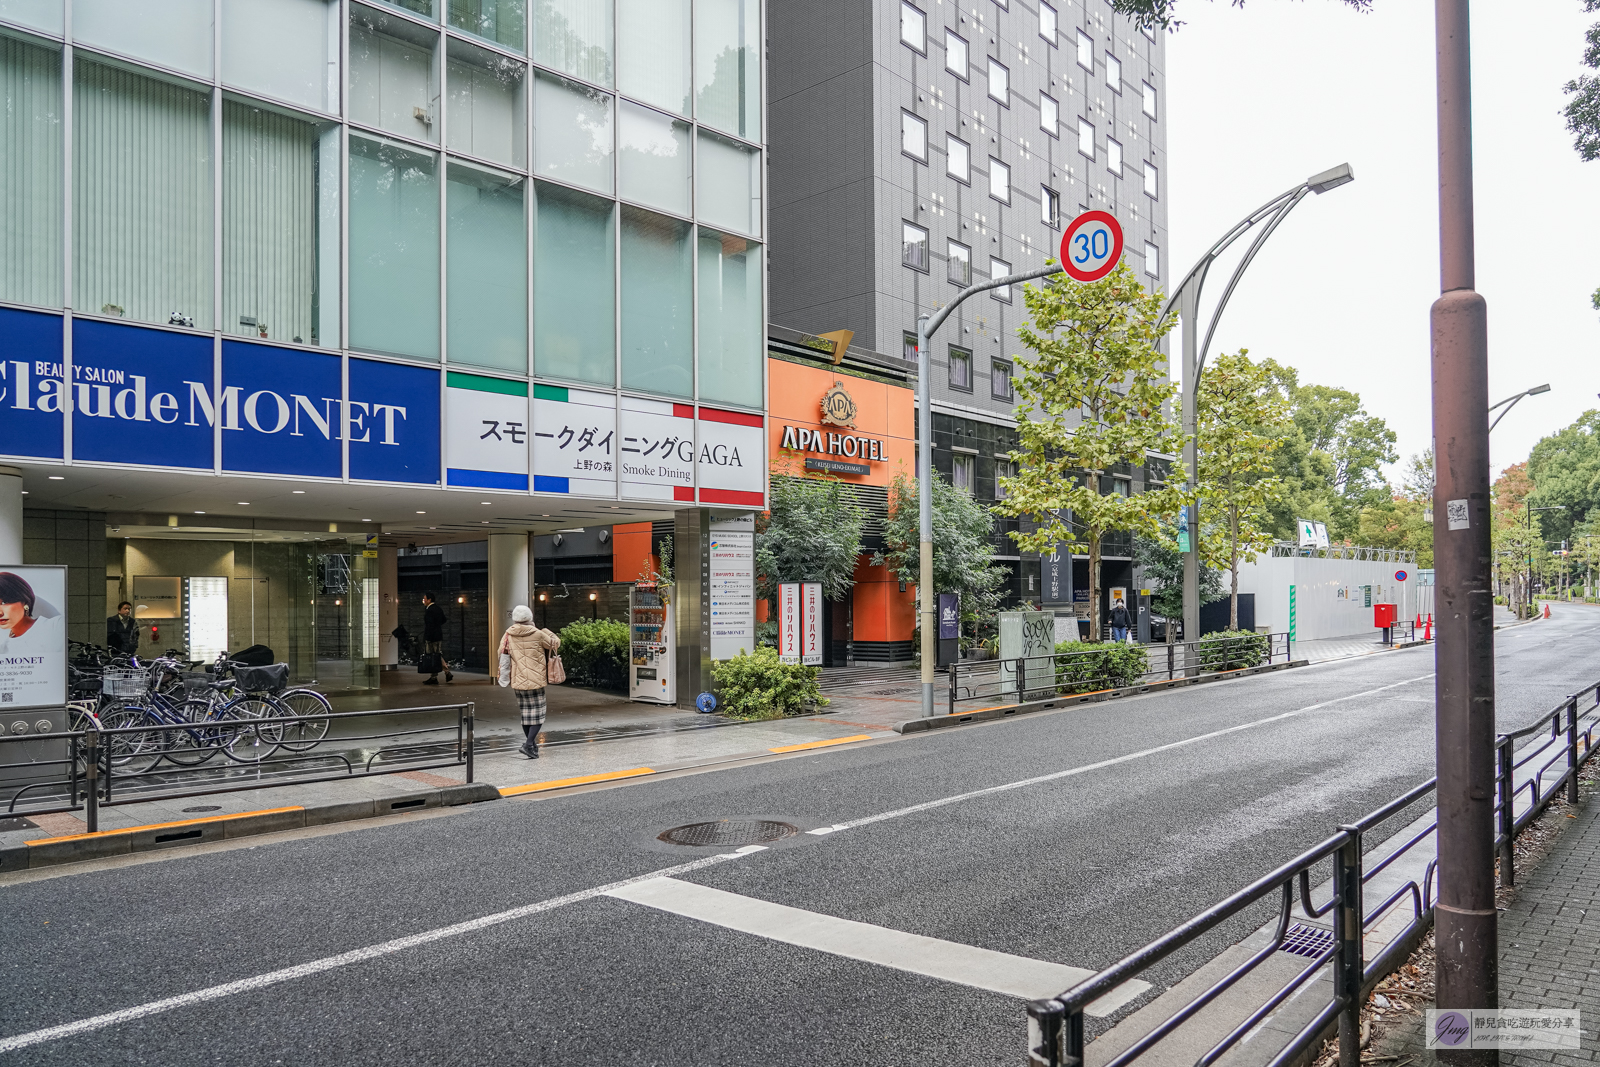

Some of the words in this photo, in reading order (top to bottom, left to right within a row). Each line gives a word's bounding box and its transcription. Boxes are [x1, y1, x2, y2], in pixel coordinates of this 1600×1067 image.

[1074, 228, 1109, 264] 30
[85, 366, 124, 385] SALON
[0, 359, 179, 424] laude
[183, 380, 407, 446] MONET
[781, 425, 825, 454] APA
[827, 431, 889, 462] HOTEL
[573, 458, 613, 473] 上野の森
[622, 462, 656, 477] Smoke
[658, 465, 691, 482] Dining
[1138, 606, 1145, 615] P
[5, 656, 44, 664] MONET
